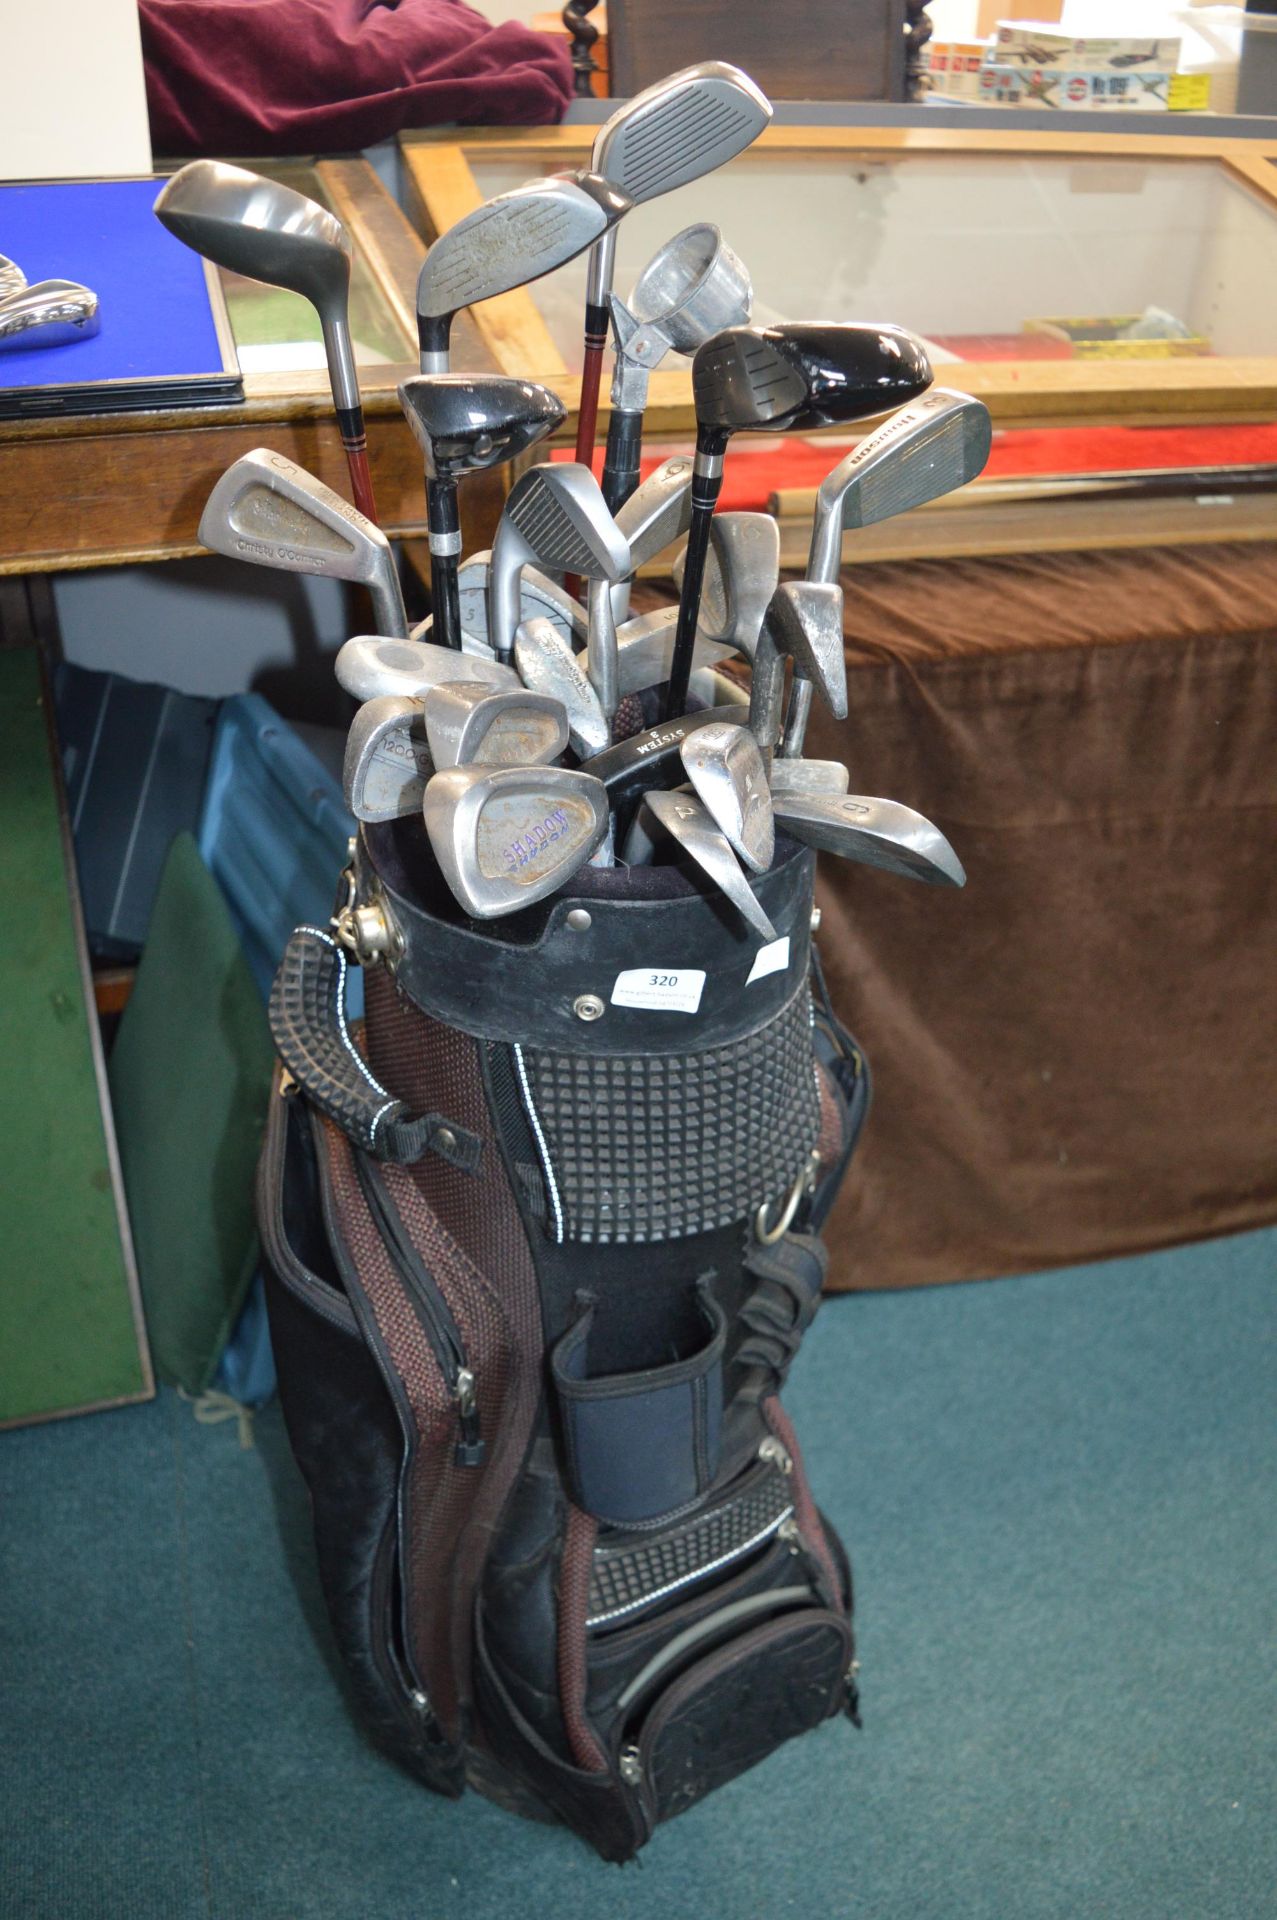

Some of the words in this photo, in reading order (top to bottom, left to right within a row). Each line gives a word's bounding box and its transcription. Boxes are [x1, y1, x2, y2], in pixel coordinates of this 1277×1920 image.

[636, 729, 685, 754] SYSTEM
[503, 808, 568, 864] SHADOW
[648, 974, 678, 988] 320
